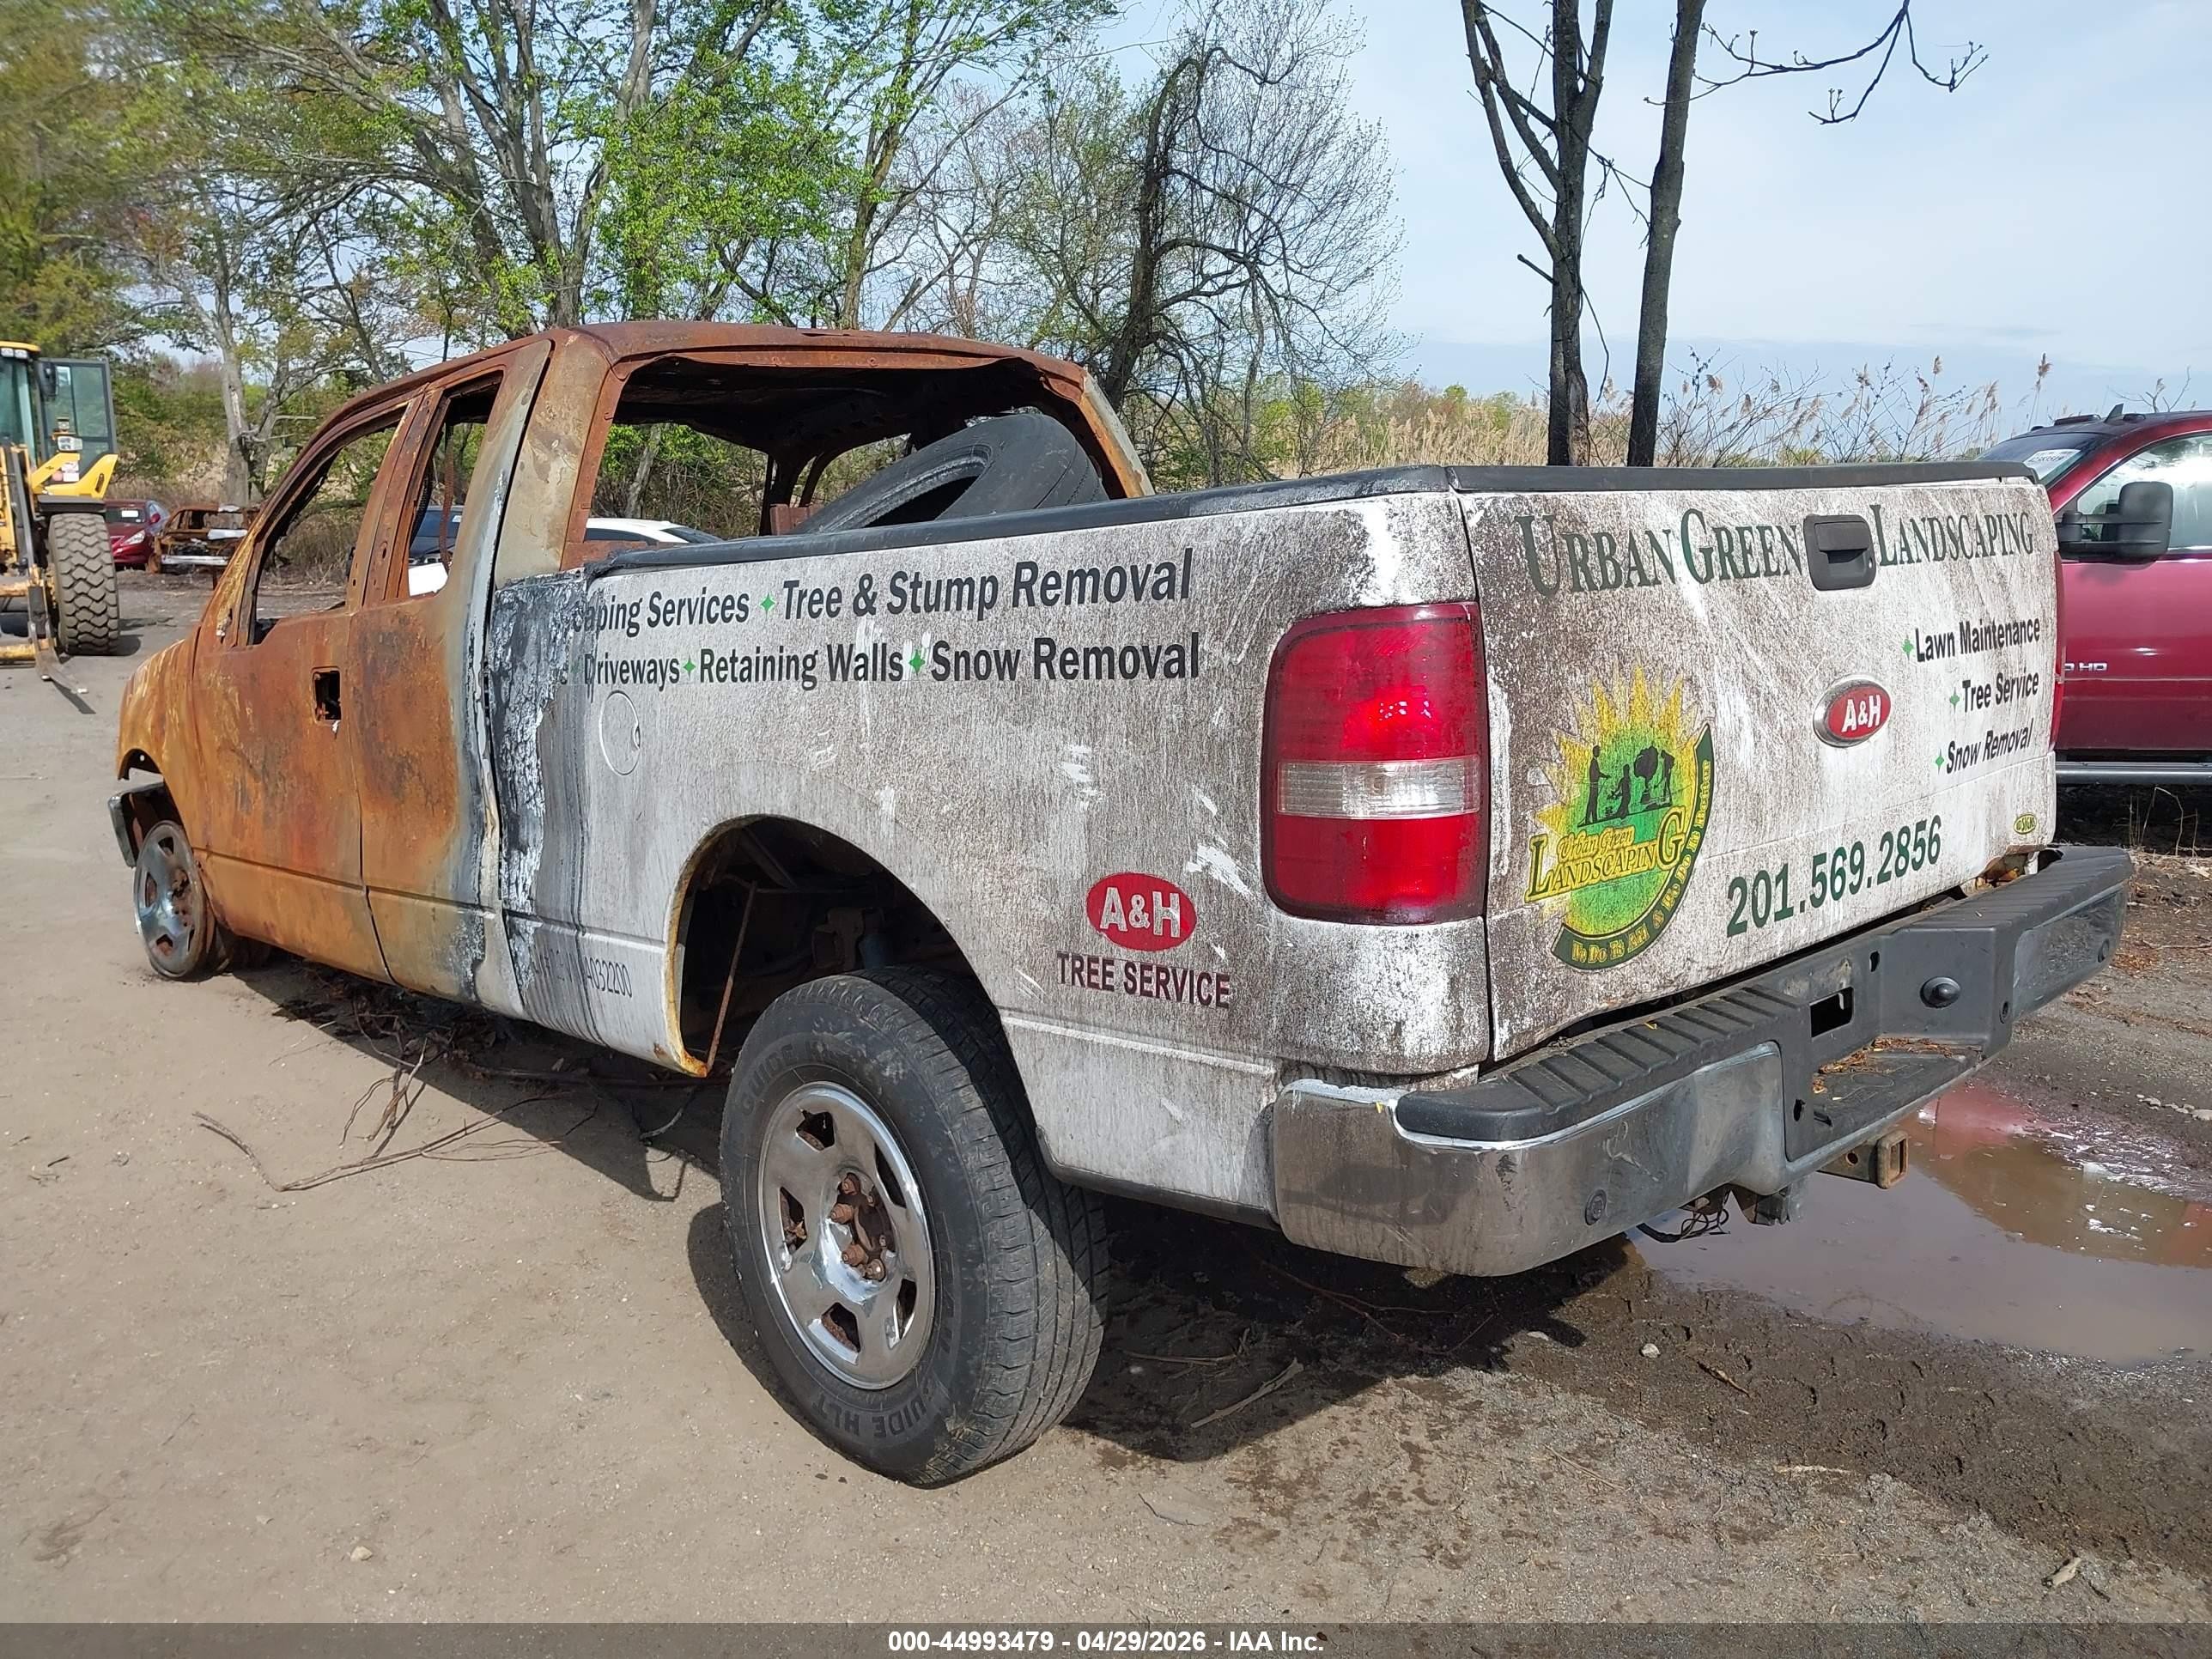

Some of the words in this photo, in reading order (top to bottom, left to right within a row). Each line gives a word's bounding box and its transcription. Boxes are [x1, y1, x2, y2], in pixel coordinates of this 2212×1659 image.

[1869, 504, 2034, 567] LANDSCAPING
[647, 586, 750, 629] Services
[782, 580, 842, 620] Tree
[852, 573, 878, 617] &
[886, 571, 999, 622] Stump
[1012, 546, 1194, 609] Removal
[584, 651, 680, 692] Driveways
[700, 645, 819, 691] Retaining
[826, 642, 904, 683] Walls
[931, 640, 1021, 682] Snow
[1033, 632, 1200, 681] Removal
[1914, 628, 1956, 663] Lawn
[1959, 617, 2040, 655] Maintenance
[2079, 662, 2107, 672] HD
[1841, 694, 1881, 732] A&H
[1962, 679, 1991, 713] Tree
[1995, 670, 2039, 704] Service
[1946, 740, 1982, 775] Snow
[1982, 718, 2034, 761] Removal
[1528, 811, 1686, 898] LANDSCAPING
[1559, 834, 1597, 859] Urban
[1600, 830, 1634, 854] Green
[1726, 814, 1942, 938] 201.569.2856
[1099, 886, 1181, 939] A&H
[1057, 952, 1115, 993] TREE
[1123, 960, 1231, 1009] SERVICE
